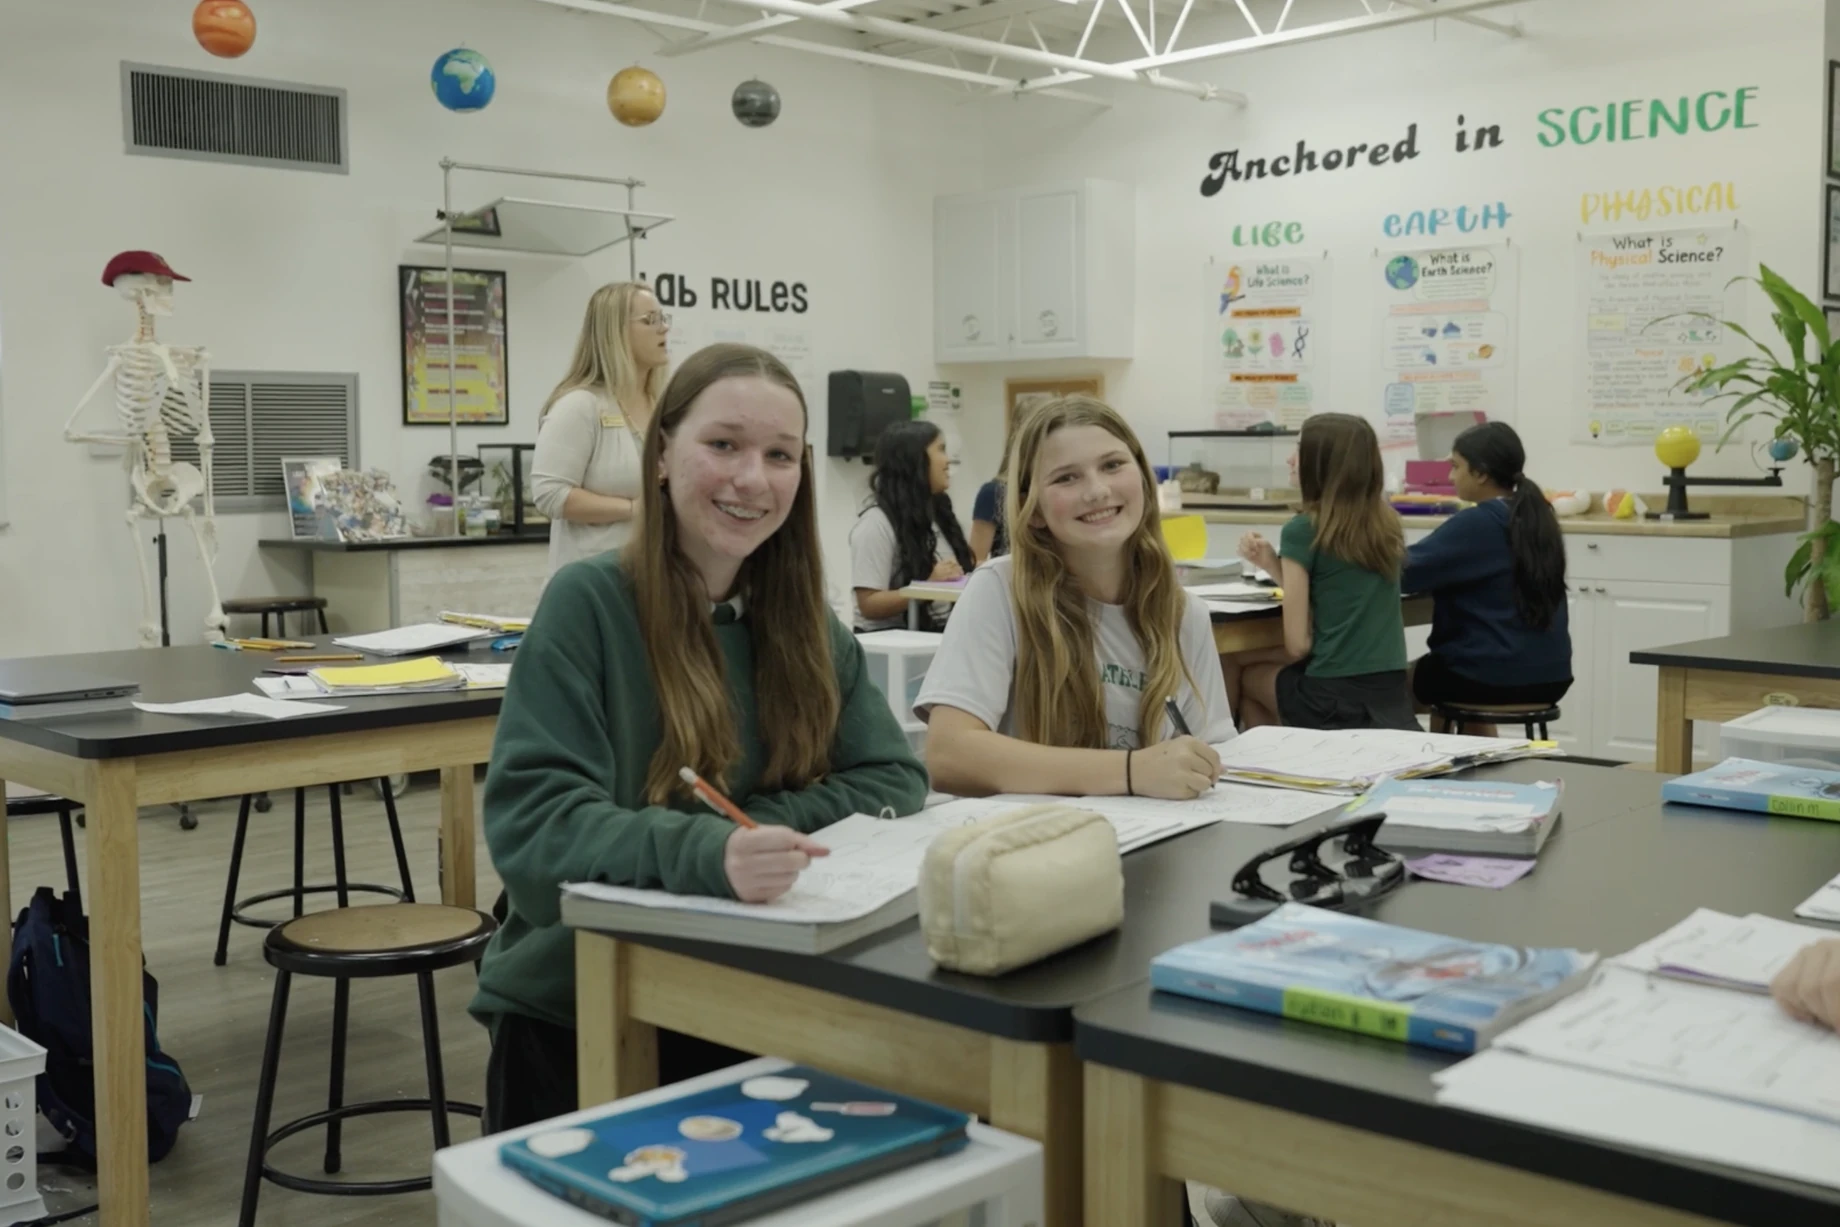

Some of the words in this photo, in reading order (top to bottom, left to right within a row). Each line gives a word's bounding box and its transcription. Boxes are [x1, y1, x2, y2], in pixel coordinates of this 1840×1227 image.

[1200, 123, 1420, 197] Anchored
[1455, 114, 1504, 153] in
[1537, 86, 1759, 148] SCIENCE
[1580, 181, 1741, 226] PHYSICAL
[1612, 236, 1653, 250] What
[1661, 236, 1673, 248] is
[1429, 253, 1459, 265] What
[1461, 253, 1471, 263] is
[1591, 250, 1652, 269] Physical
[1658, 247, 1724, 264] Science?
[1256, 265, 1279, 275] What
[1281, 264, 1290, 274] is
[1422, 265, 1447, 277] Earth
[1450, 262, 1493, 276] Science?
[1248, 276, 1264, 288] Life
[1266, 274, 1310, 287] Science?
[640, 272, 697, 308] ab
